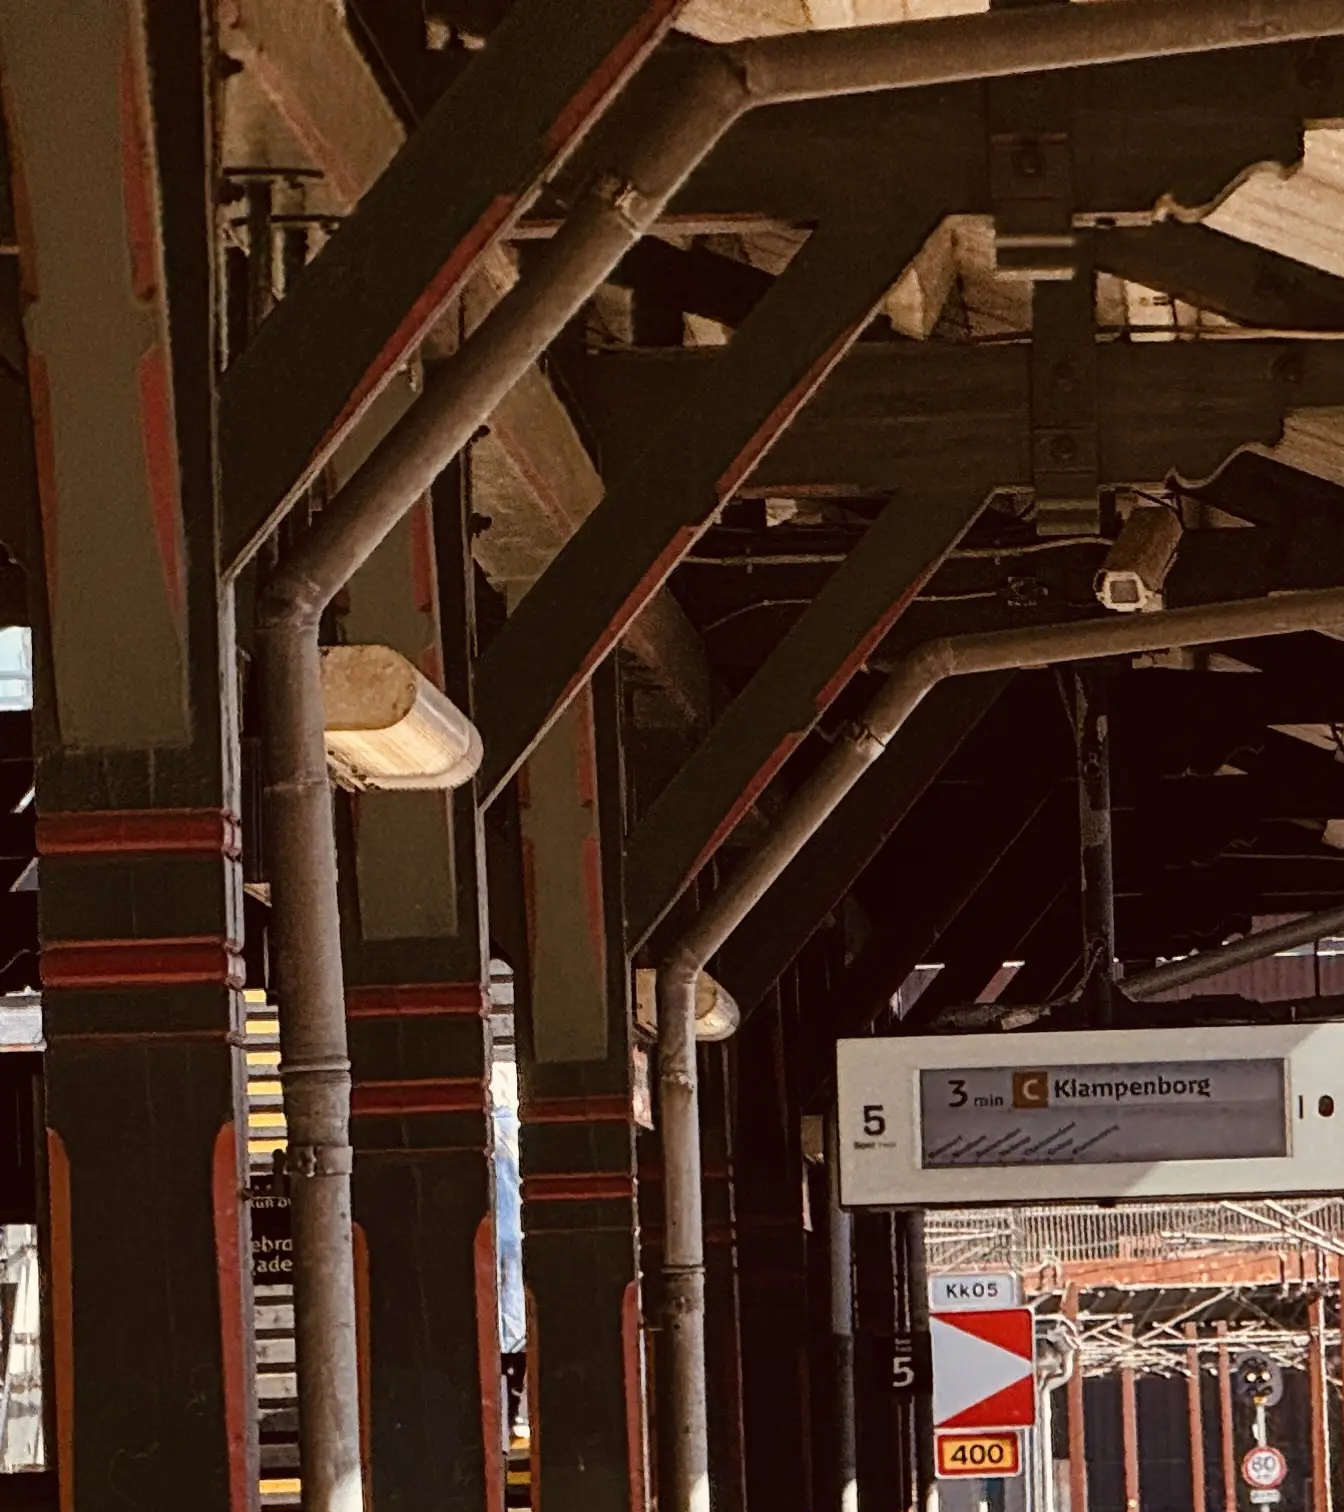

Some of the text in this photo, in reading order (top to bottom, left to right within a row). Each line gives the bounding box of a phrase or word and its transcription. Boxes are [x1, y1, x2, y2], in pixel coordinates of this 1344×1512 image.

[947, 1075, 1211, 1107] 3 min C Klampenborg
[863, 1105, 886, 1136] 5
[946, 1283, 998, 1299] Kk05
[893, 1356, 915, 1387] 5
[950, 1443, 1004, 1465] 400
